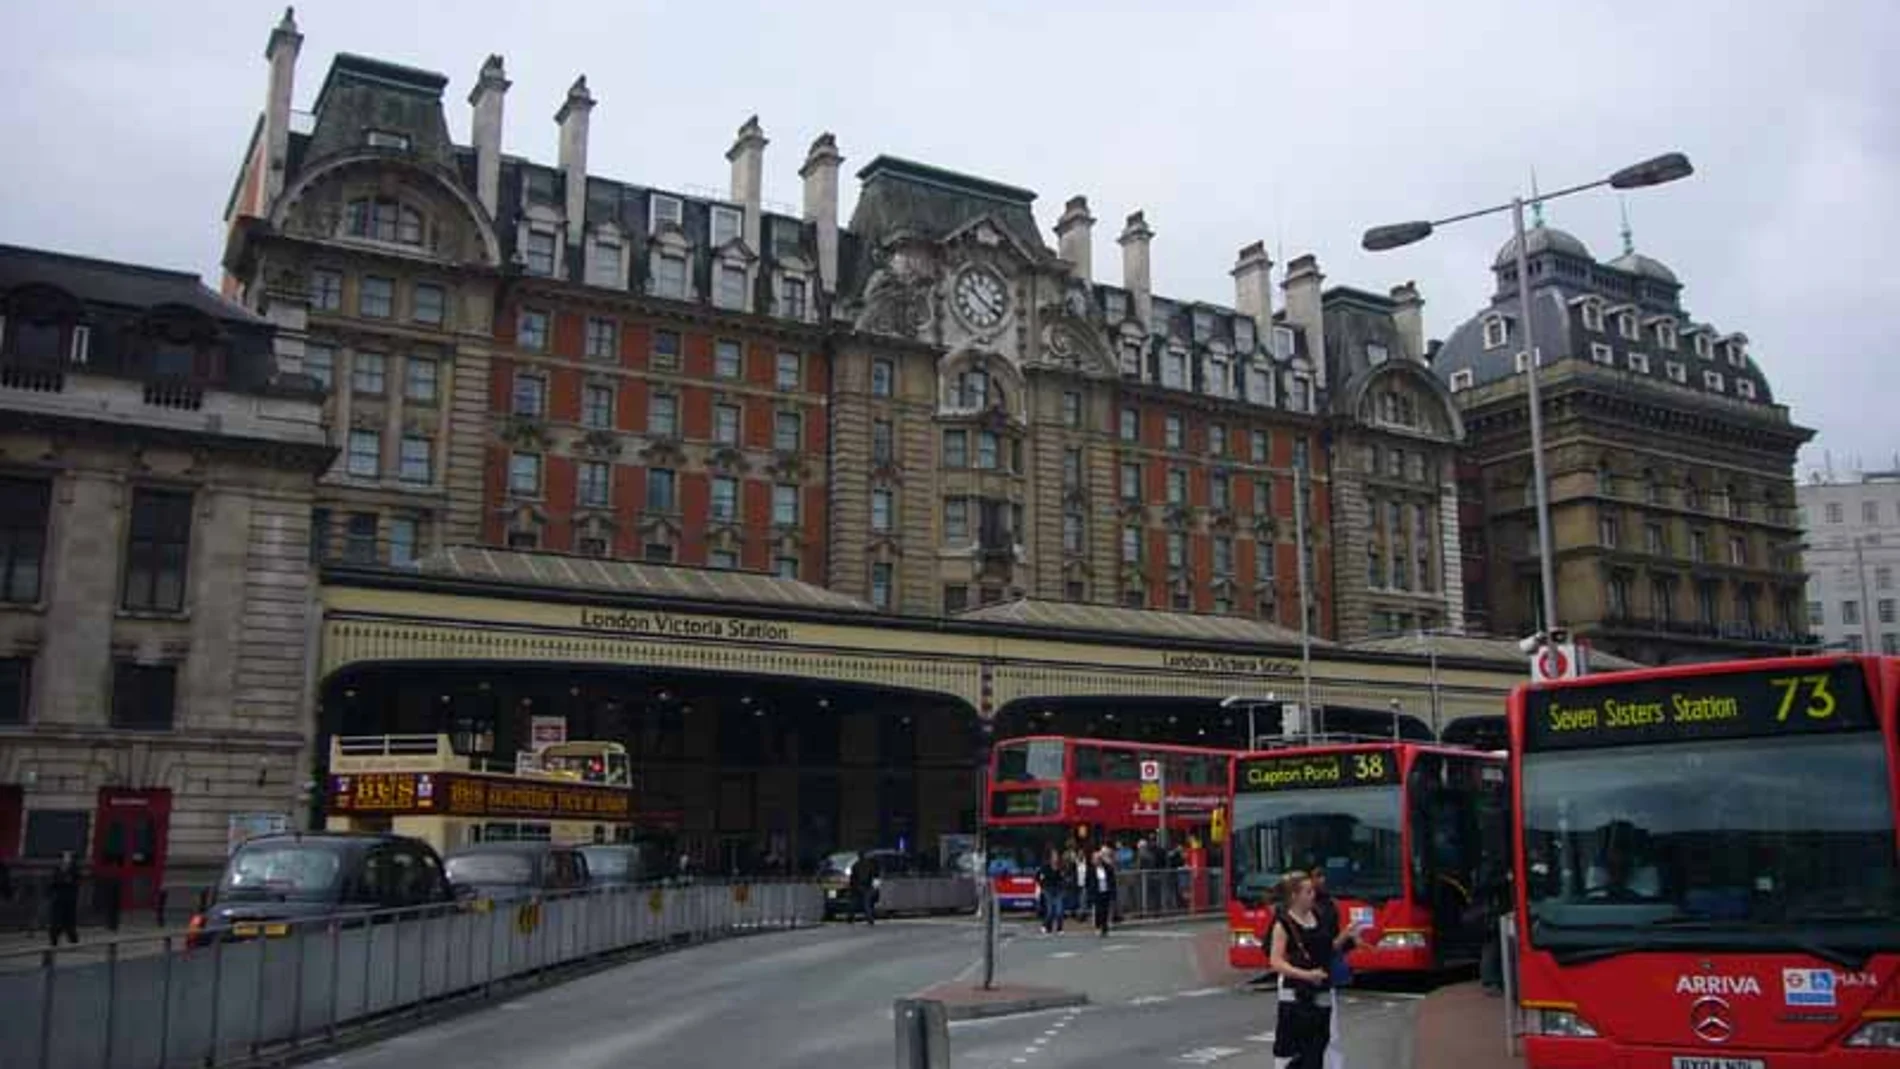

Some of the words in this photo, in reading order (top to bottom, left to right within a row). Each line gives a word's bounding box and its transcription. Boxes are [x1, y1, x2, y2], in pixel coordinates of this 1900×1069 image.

[581, 608, 649, 630] London
[655, 614, 722, 636] Victoria
[729, 619, 789, 640] Station
[1161, 650, 1209, 668] London
[1770, 674, 1837, 721] 73
[1549, 703, 1598, 730] Seven
[1604, 699, 1665, 726] Sisters
[1672, 693, 1738, 721] Station
[1247, 768, 1301, 786] Clapton
[1303, 764, 1340, 781] Pond
[1353, 753, 1384, 778] 38
[1676, 975, 1761, 994] ARRIVA
